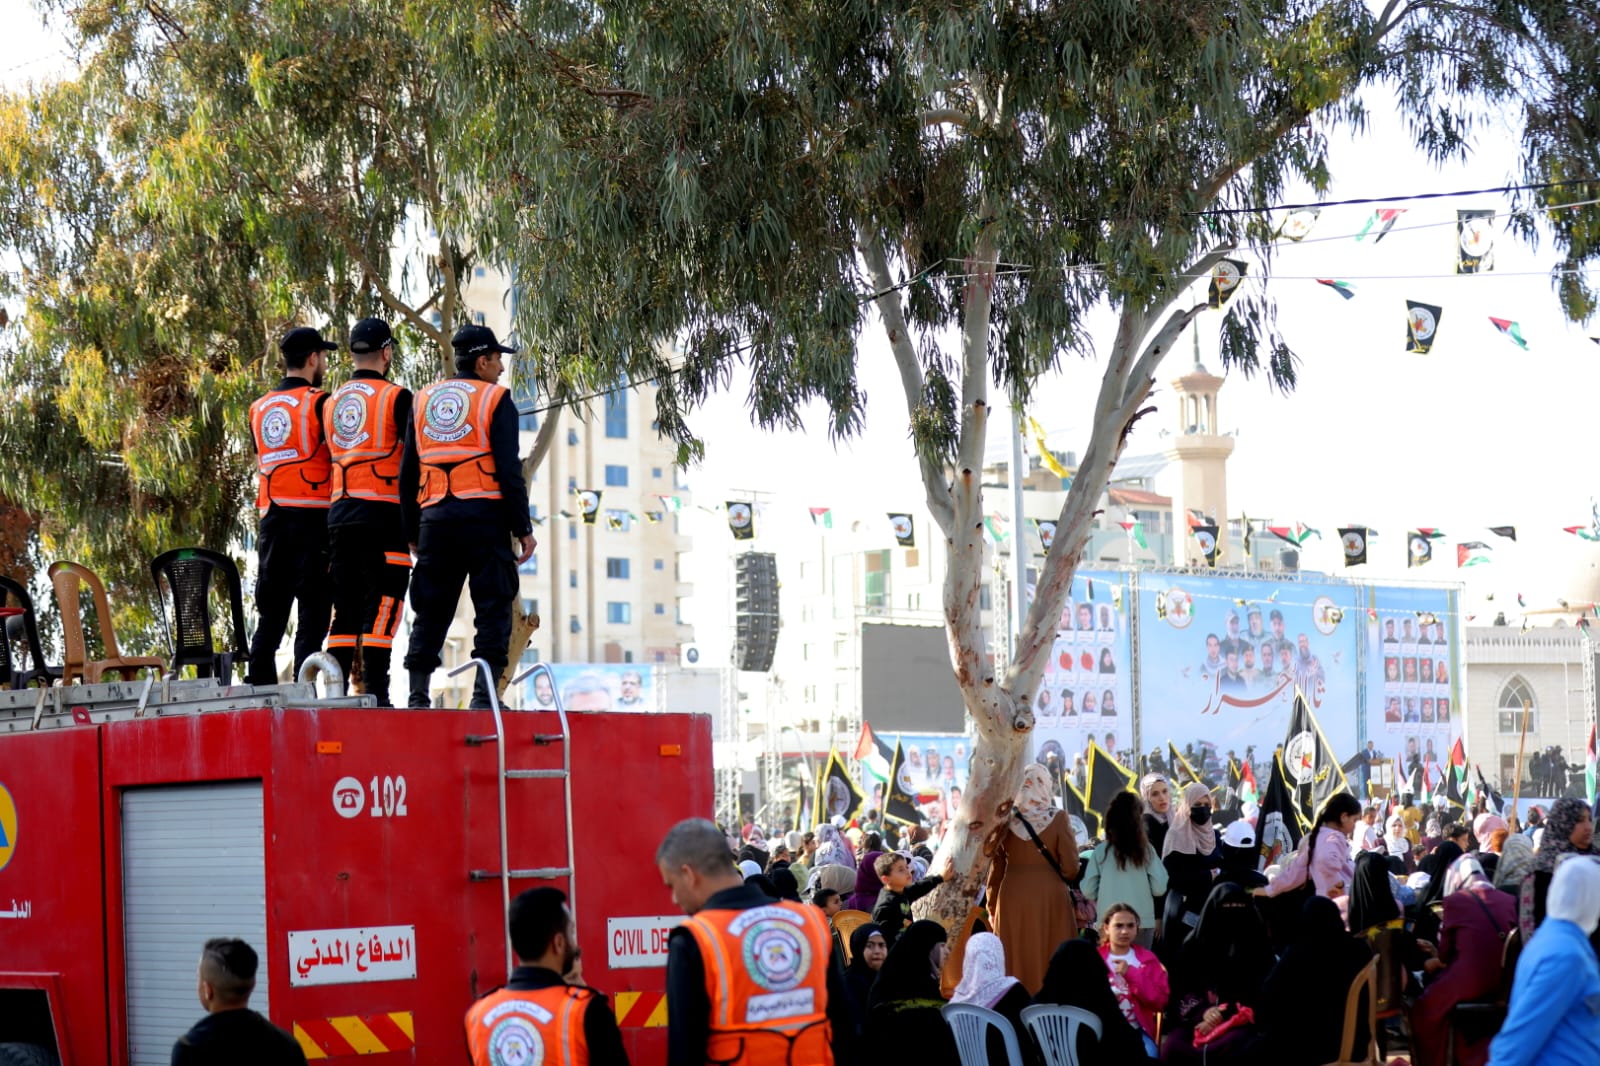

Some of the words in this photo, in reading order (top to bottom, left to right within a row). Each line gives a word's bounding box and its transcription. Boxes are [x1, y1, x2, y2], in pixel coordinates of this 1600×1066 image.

[370, 775, 407, 817] 102
[296, 937, 350, 979] المدني
[356, 934, 411, 972] الدفاع
[613, 929, 648, 956] CIVIL
[651, 927, 674, 955] DE
